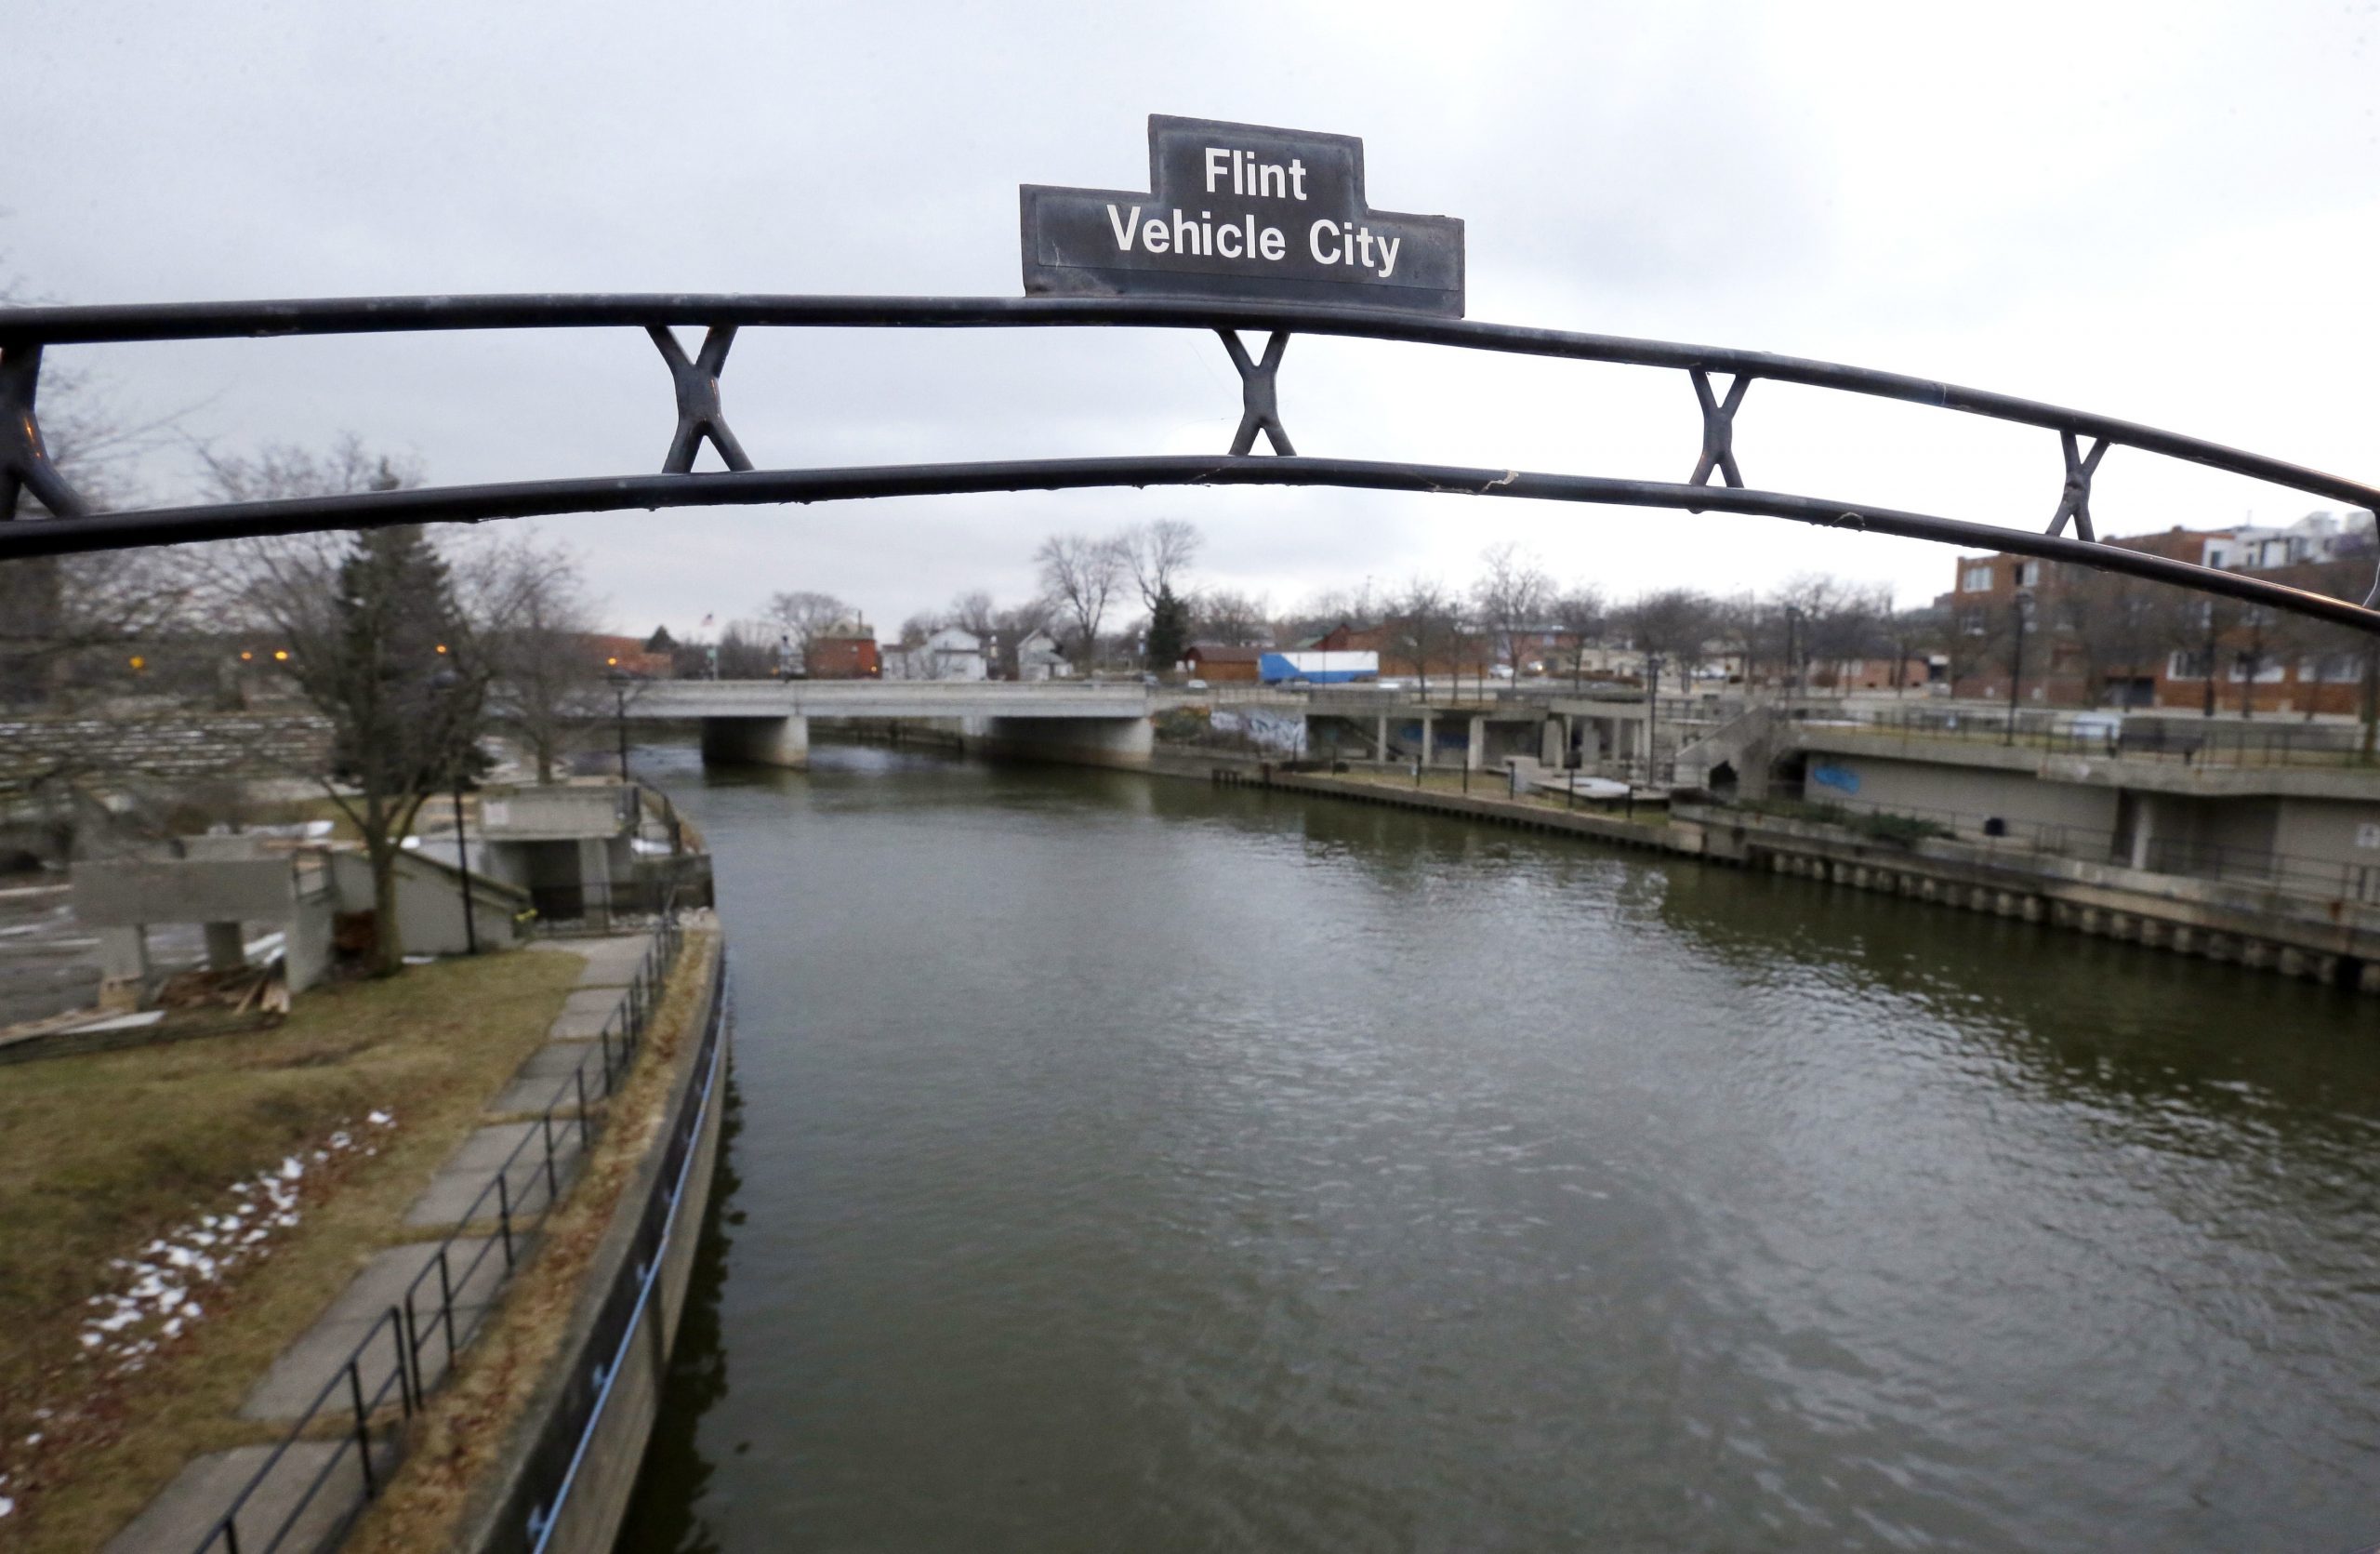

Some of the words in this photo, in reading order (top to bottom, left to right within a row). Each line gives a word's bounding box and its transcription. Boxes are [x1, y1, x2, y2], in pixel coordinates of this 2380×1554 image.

[1205, 147, 1307, 201] Flint
[1106, 204, 1286, 261] Vehicle
[1309, 219, 1401, 278] City
